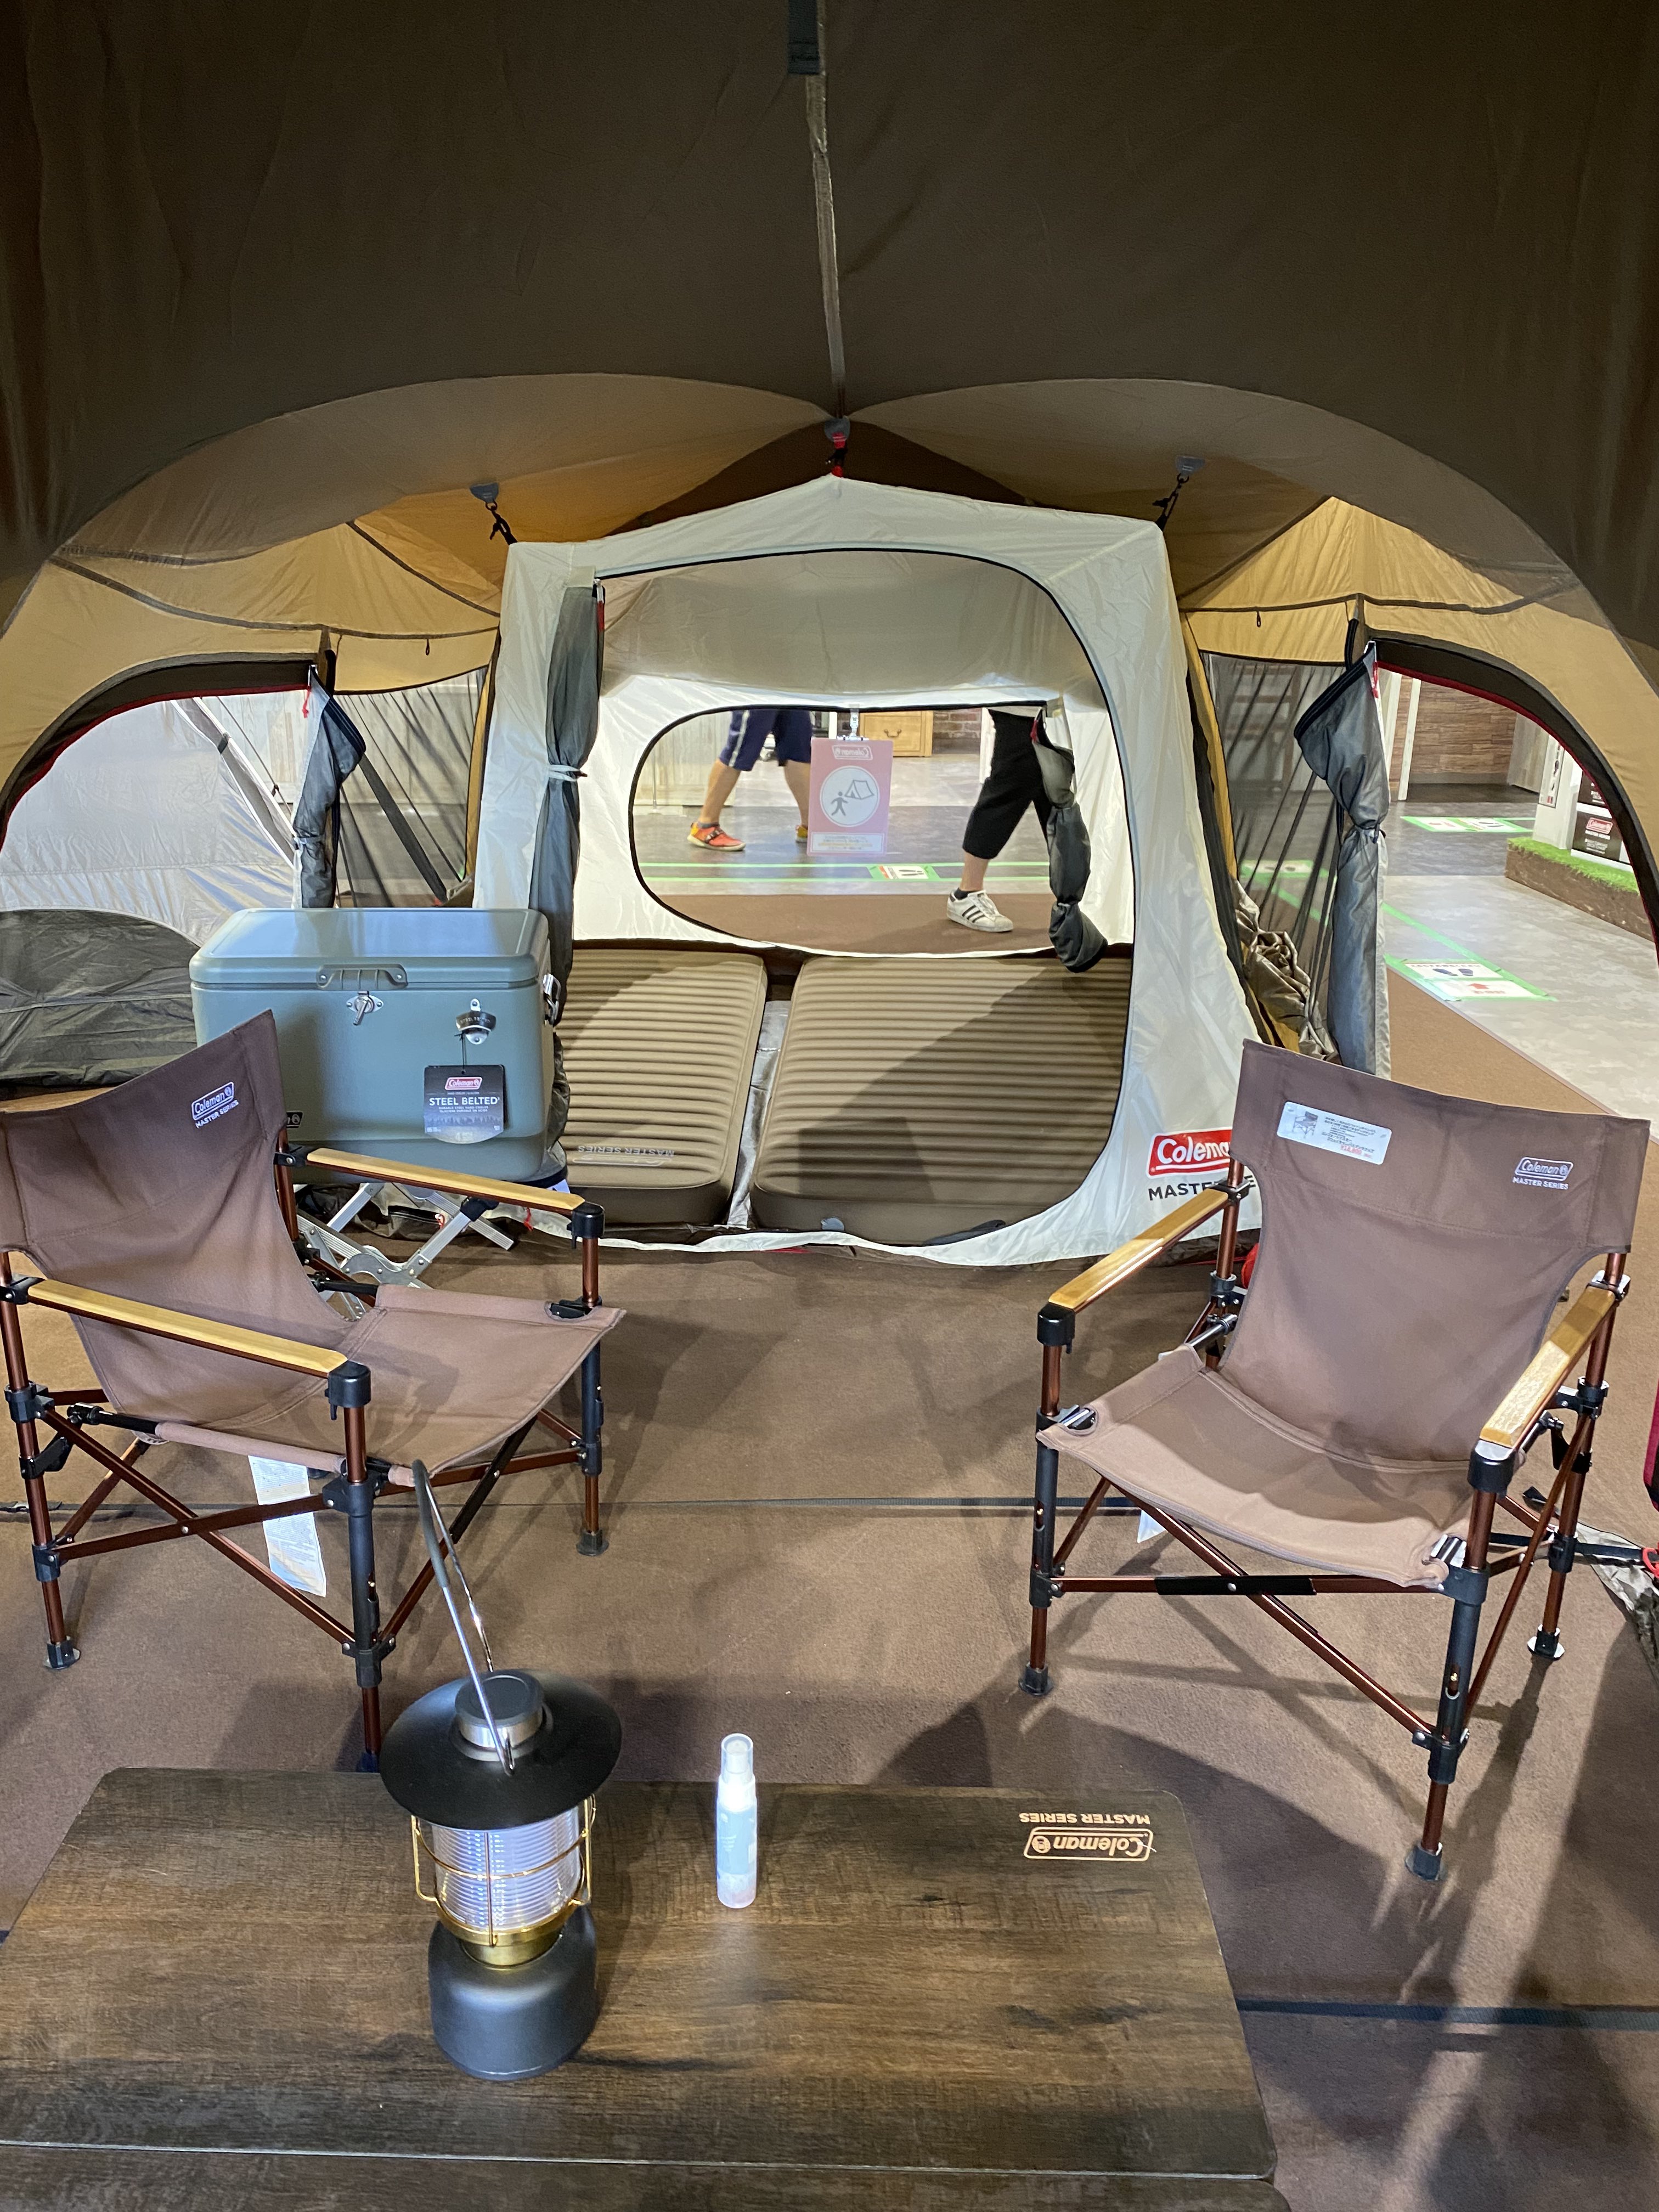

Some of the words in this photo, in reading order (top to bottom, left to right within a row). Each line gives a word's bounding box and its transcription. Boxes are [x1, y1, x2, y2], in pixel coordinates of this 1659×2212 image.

[195, 1092, 225, 1114] Coleman
[429, 1098, 459, 1106] STEEL
[195, 1111, 220, 1128] MASTER
[219, 1100, 239, 1114] SERIES
[578, 1146, 621, 1154] SERIES
[1157, 1136, 1231, 1164] Colema
[1521, 1160, 1559, 1174] Coleman
[1513, 1177, 1542, 1187] MASTER
[1543, 1181, 1569, 1190] SERIES
[1019, 1812, 1077, 1824] SERIES
[1081, 1813, 1151, 1825] MASTER
[1053, 1836, 1143, 1857] Coleman
